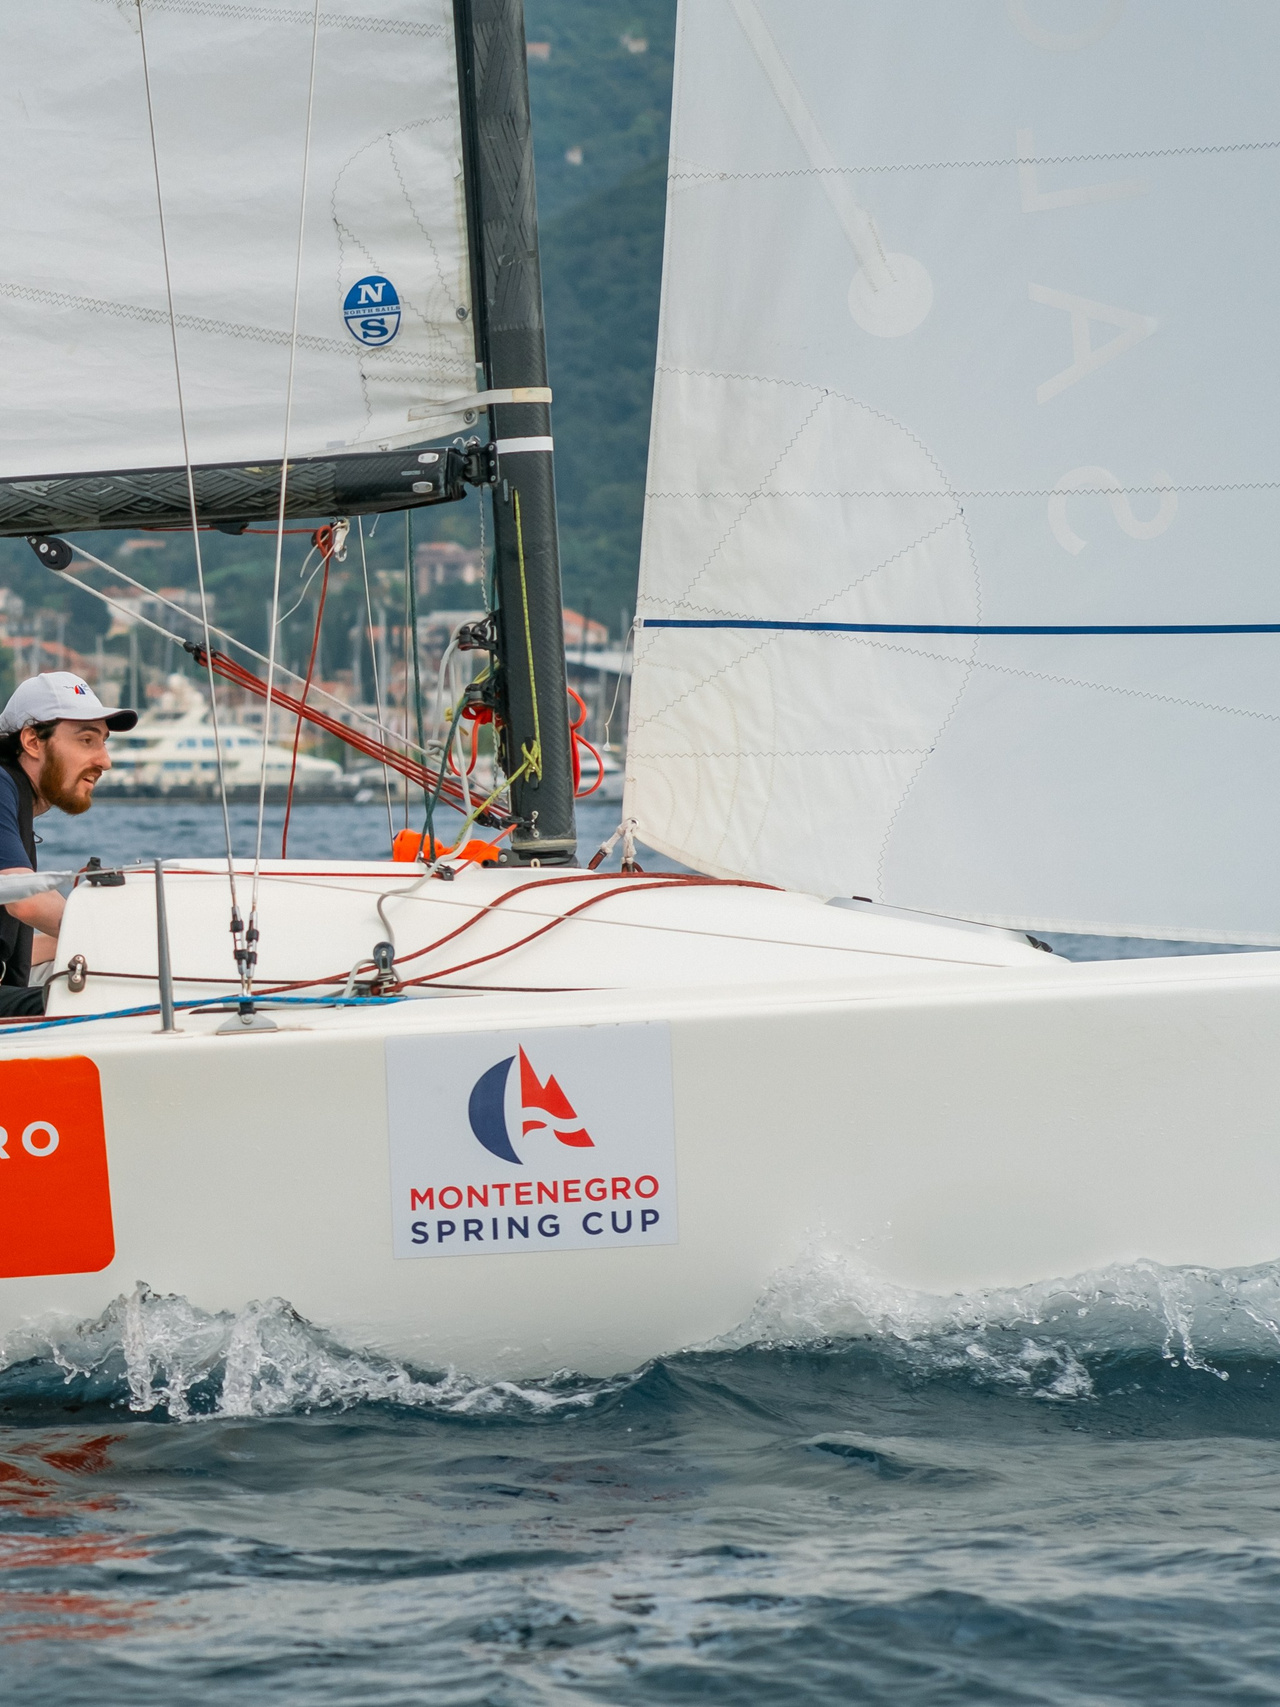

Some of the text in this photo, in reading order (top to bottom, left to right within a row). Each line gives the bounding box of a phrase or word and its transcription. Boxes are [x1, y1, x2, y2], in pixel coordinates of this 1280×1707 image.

[357, 282, 386, 304] N
[343, 305, 401, 316] NORTH SAILS
[360, 317, 389, 339] S
[410, 1174, 660, 1211] MONTENEGRO
[411, 1208, 660, 1245] SPRING CUP
